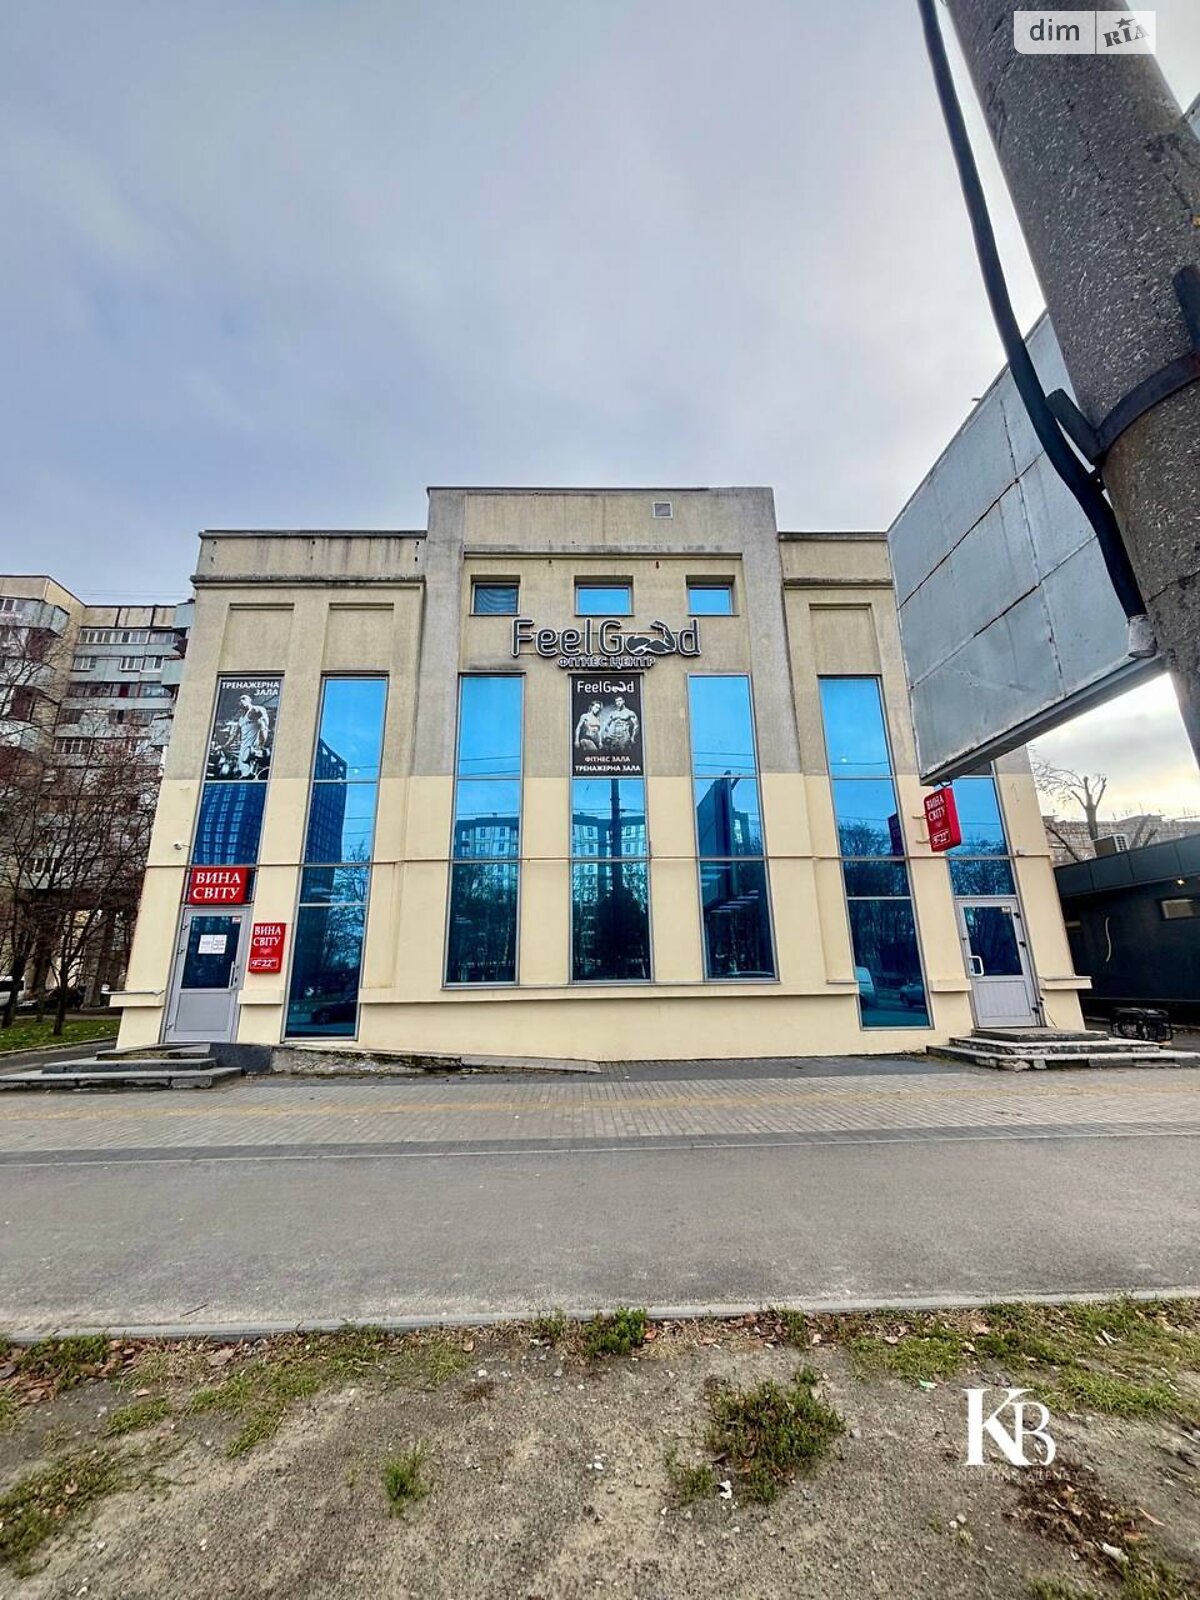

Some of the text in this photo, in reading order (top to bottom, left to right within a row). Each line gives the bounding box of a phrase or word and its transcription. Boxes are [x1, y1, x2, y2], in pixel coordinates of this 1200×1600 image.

[558, 655, 656, 669] ФІТНЕС ЦЕНТР
[221, 680, 280, 689] ТРЕНАЖЕРНА
[254, 688, 279, 696] ЗАЛА
[584, 755, 631, 763] ФІТНЕС ЗАЛА
[195, 872, 241, 884] ВИНА
[193, 887, 240, 899] СВІТУ
[254, 926, 282, 935] ВИНА
[253, 937, 281, 947] СВІТУ
